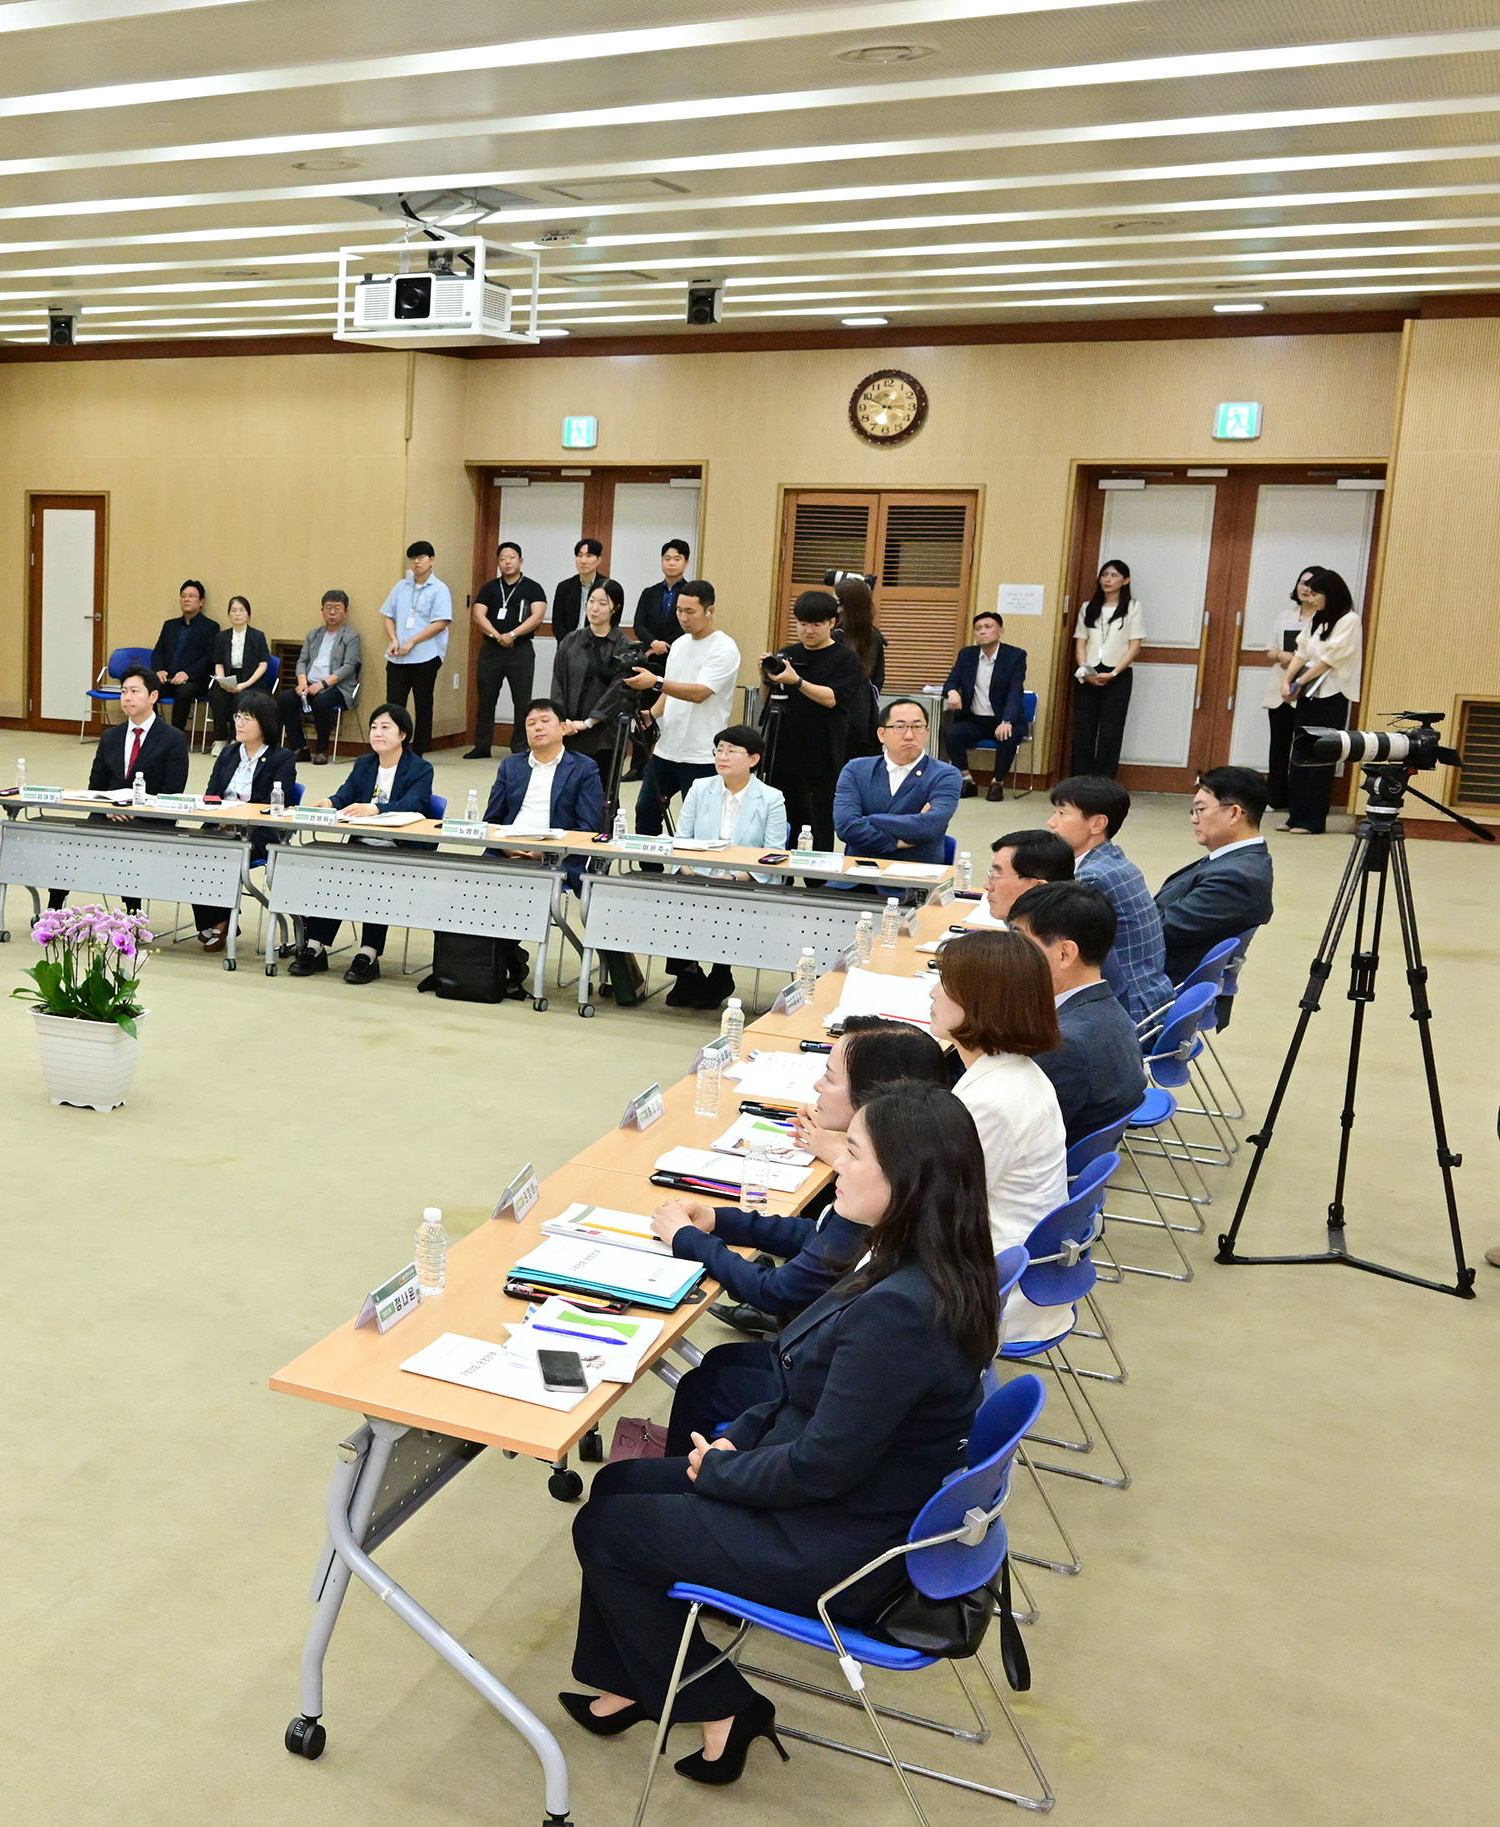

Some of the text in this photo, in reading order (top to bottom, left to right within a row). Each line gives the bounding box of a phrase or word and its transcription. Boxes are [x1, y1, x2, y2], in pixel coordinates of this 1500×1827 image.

[872, 383, 880, 391] 11
[883, 378, 895, 388] 12
[863, 392, 873, 401] 10
[905, 391, 914, 400] 2
[859, 403, 867, 412] 9
[908, 402, 917, 411] 3
[860, 413, 870, 422] 8
[902, 413, 911, 422] 4
[869, 423, 878, 431] 7
[881, 425, 890, 434] 6
[894, 422, 903, 432] 5
[394, 1286, 416, 1312] 정나은
